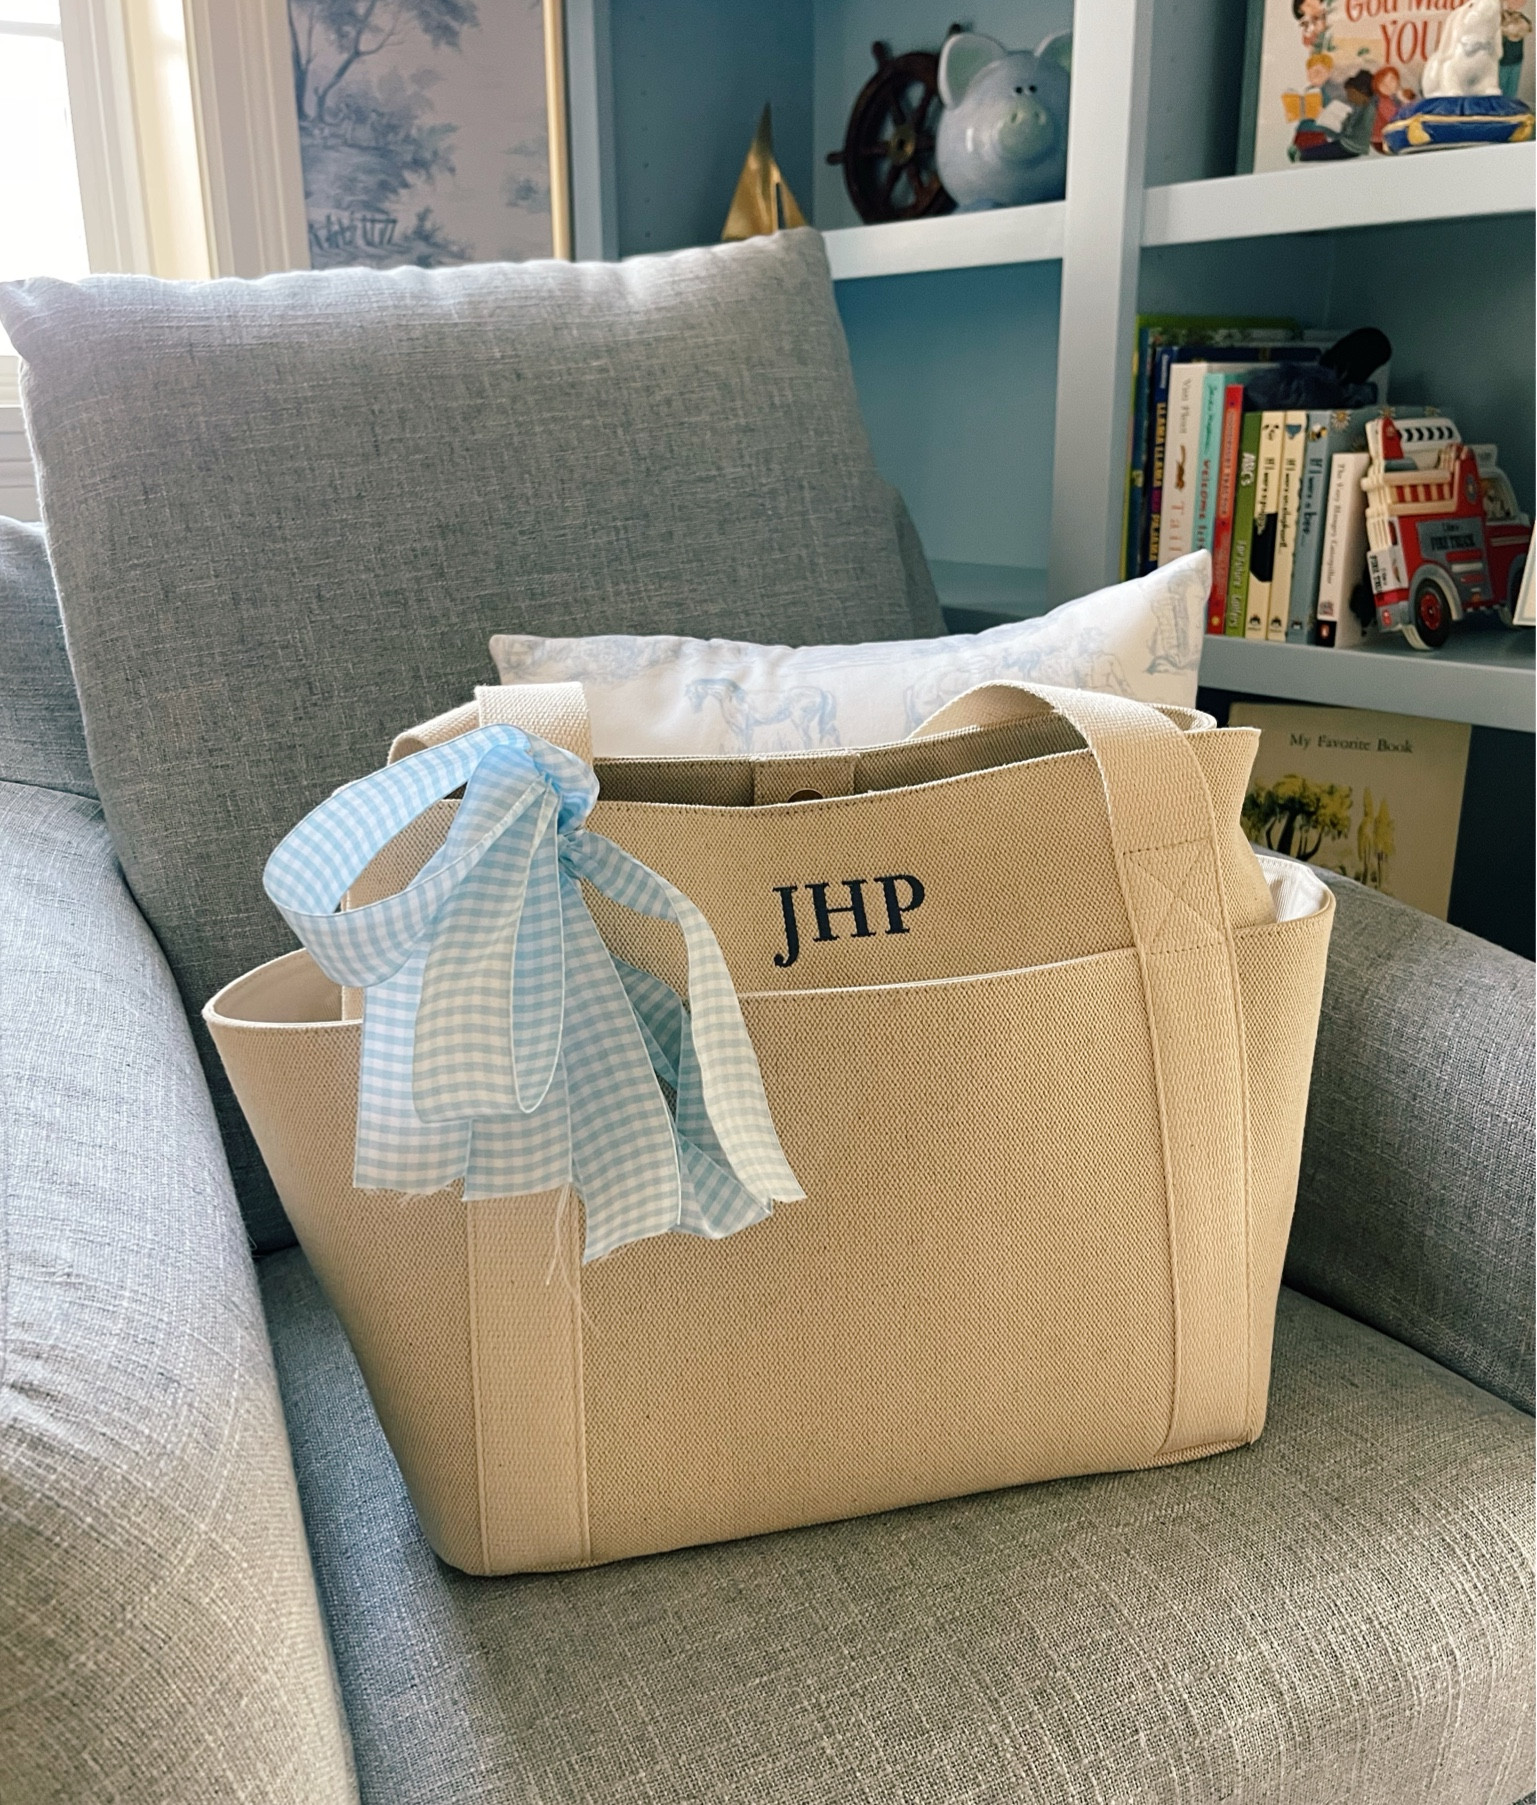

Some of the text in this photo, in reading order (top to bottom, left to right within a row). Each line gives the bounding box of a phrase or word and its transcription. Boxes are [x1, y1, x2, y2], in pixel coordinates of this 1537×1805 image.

[1380, 20, 1442, 64] YOU
[1338, 464, 1346, 479] The
[1335, 483, 1344, 502] Very
[1289, 733, 1415, 753] My Favorite Book
[772, 873, 926, 968] JHP
